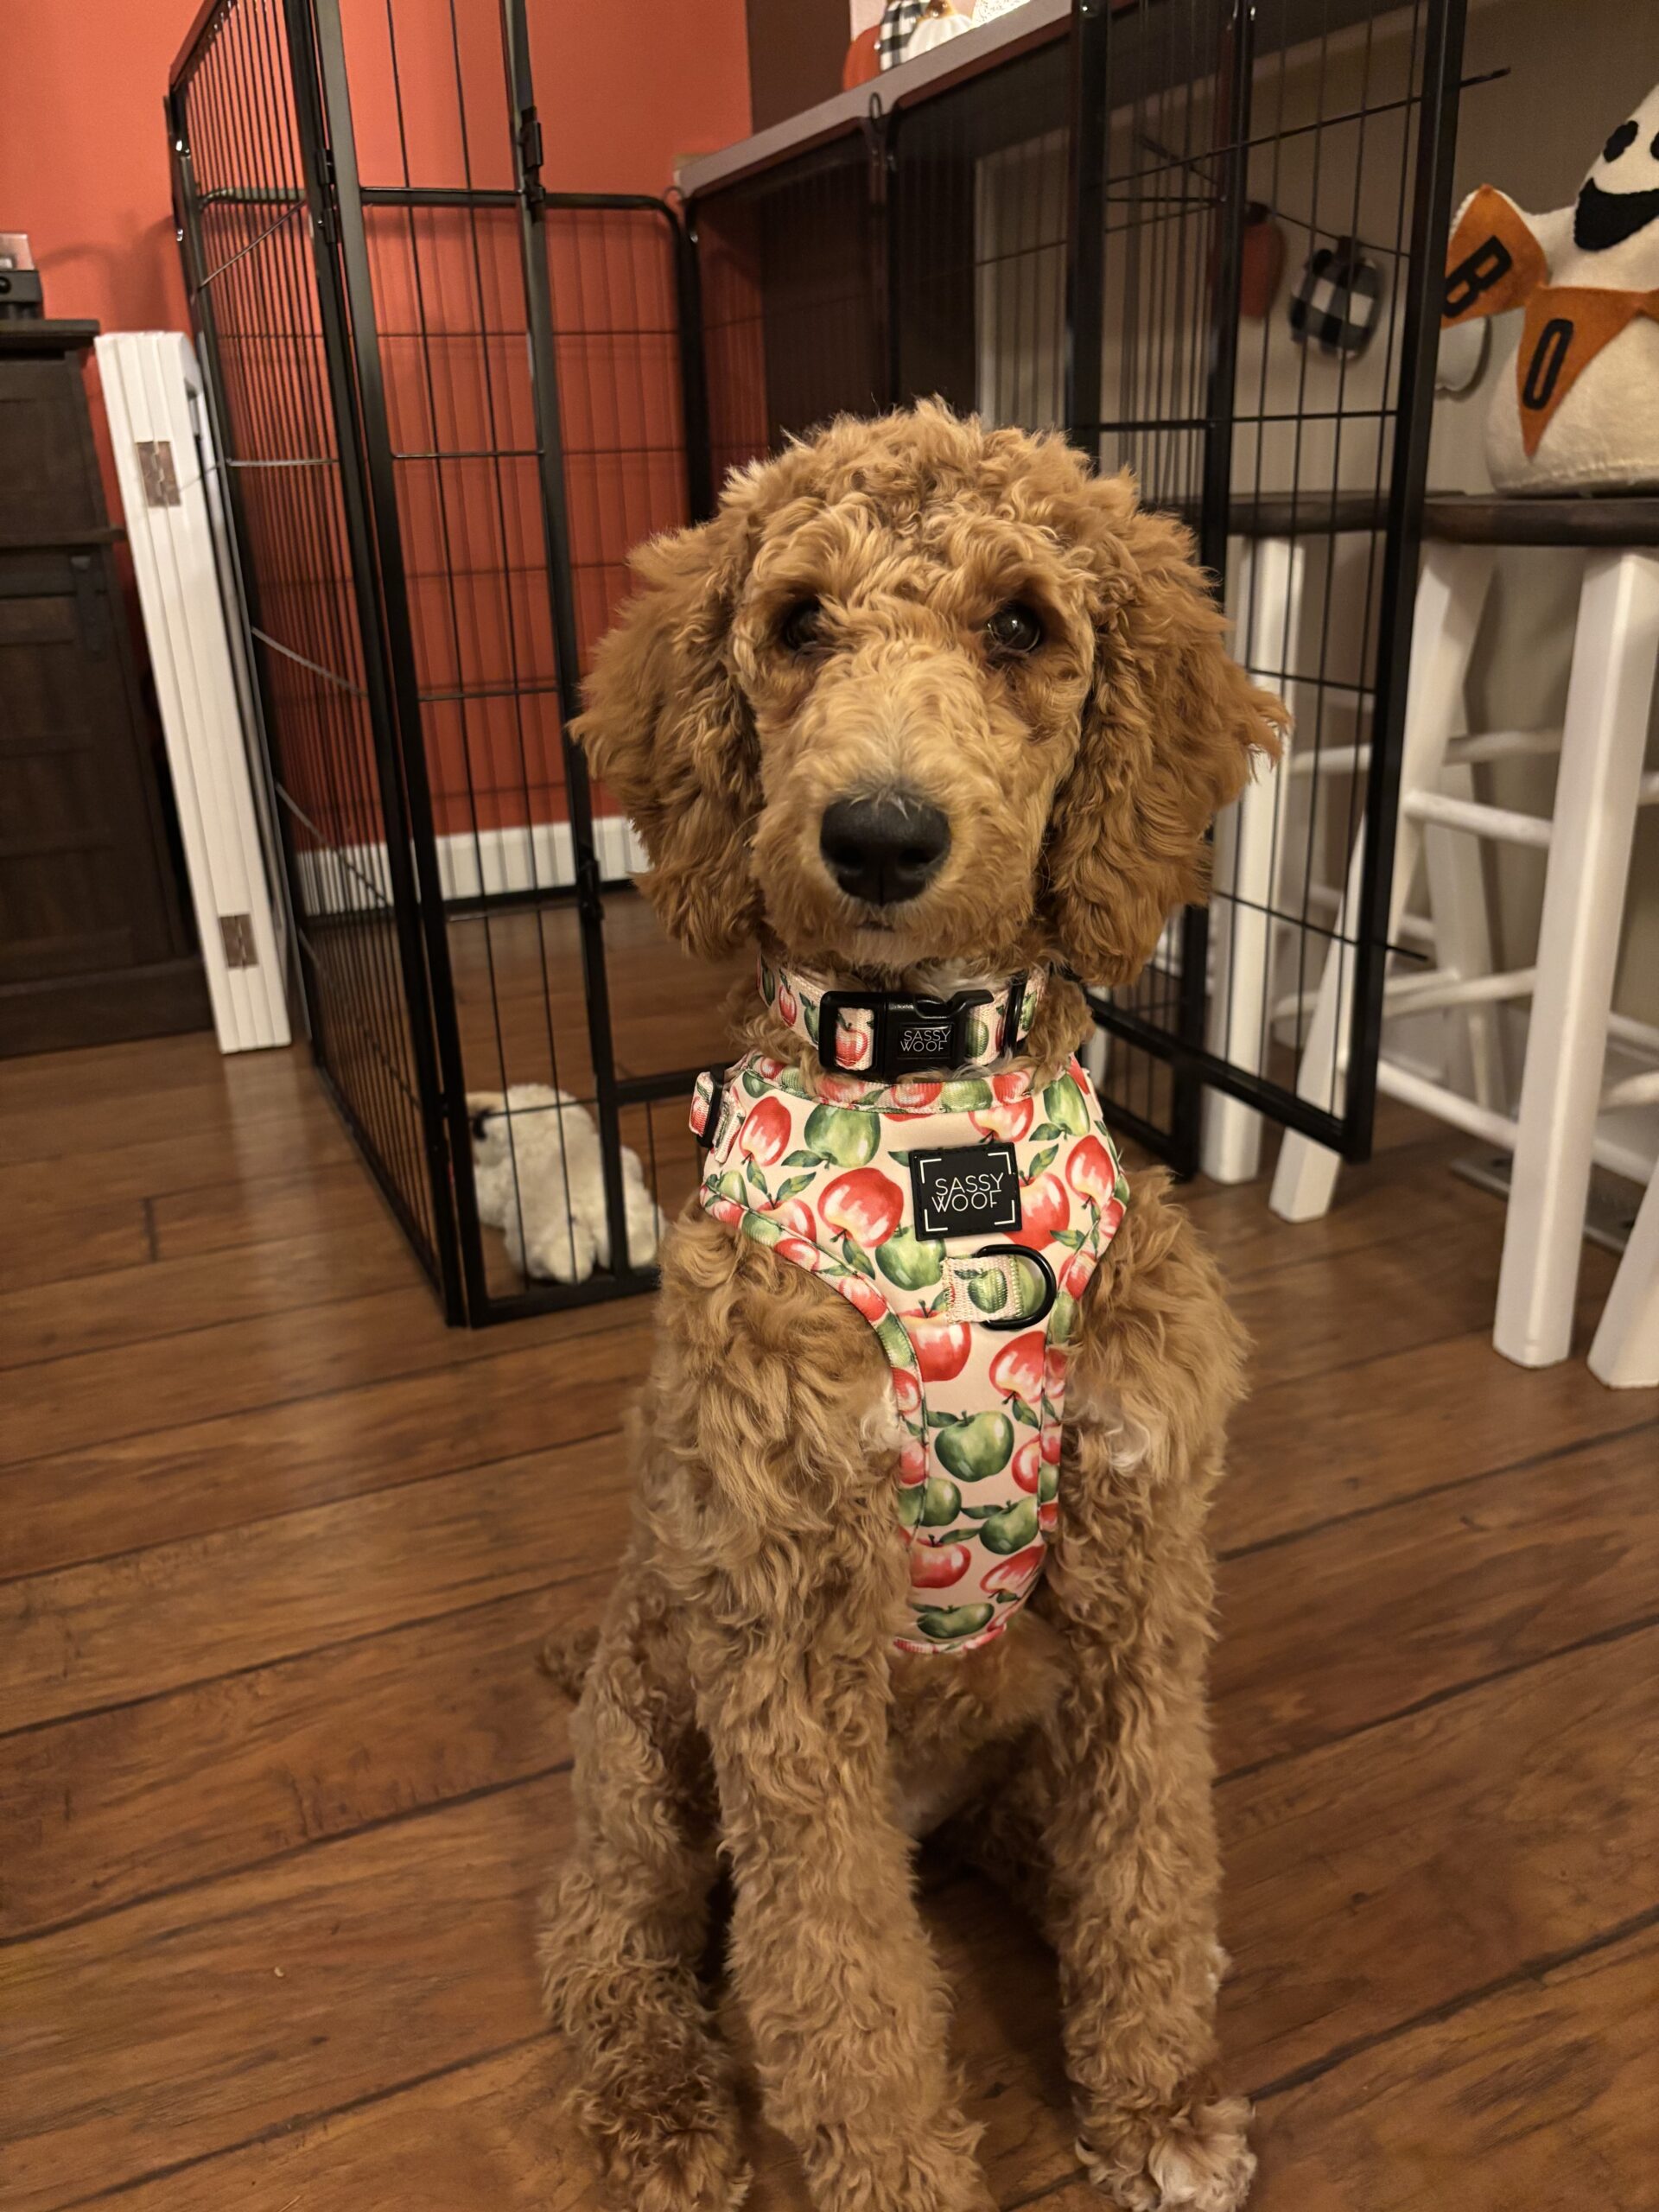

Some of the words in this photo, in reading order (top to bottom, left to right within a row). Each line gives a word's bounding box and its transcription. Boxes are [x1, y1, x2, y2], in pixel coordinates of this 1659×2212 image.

[903, 1029, 951, 1042] SASSY
[899, 1039, 948, 1052] WOOF
[934, 1171, 1004, 1197] SASSY
[931, 1189, 1002, 1213] WOOF
